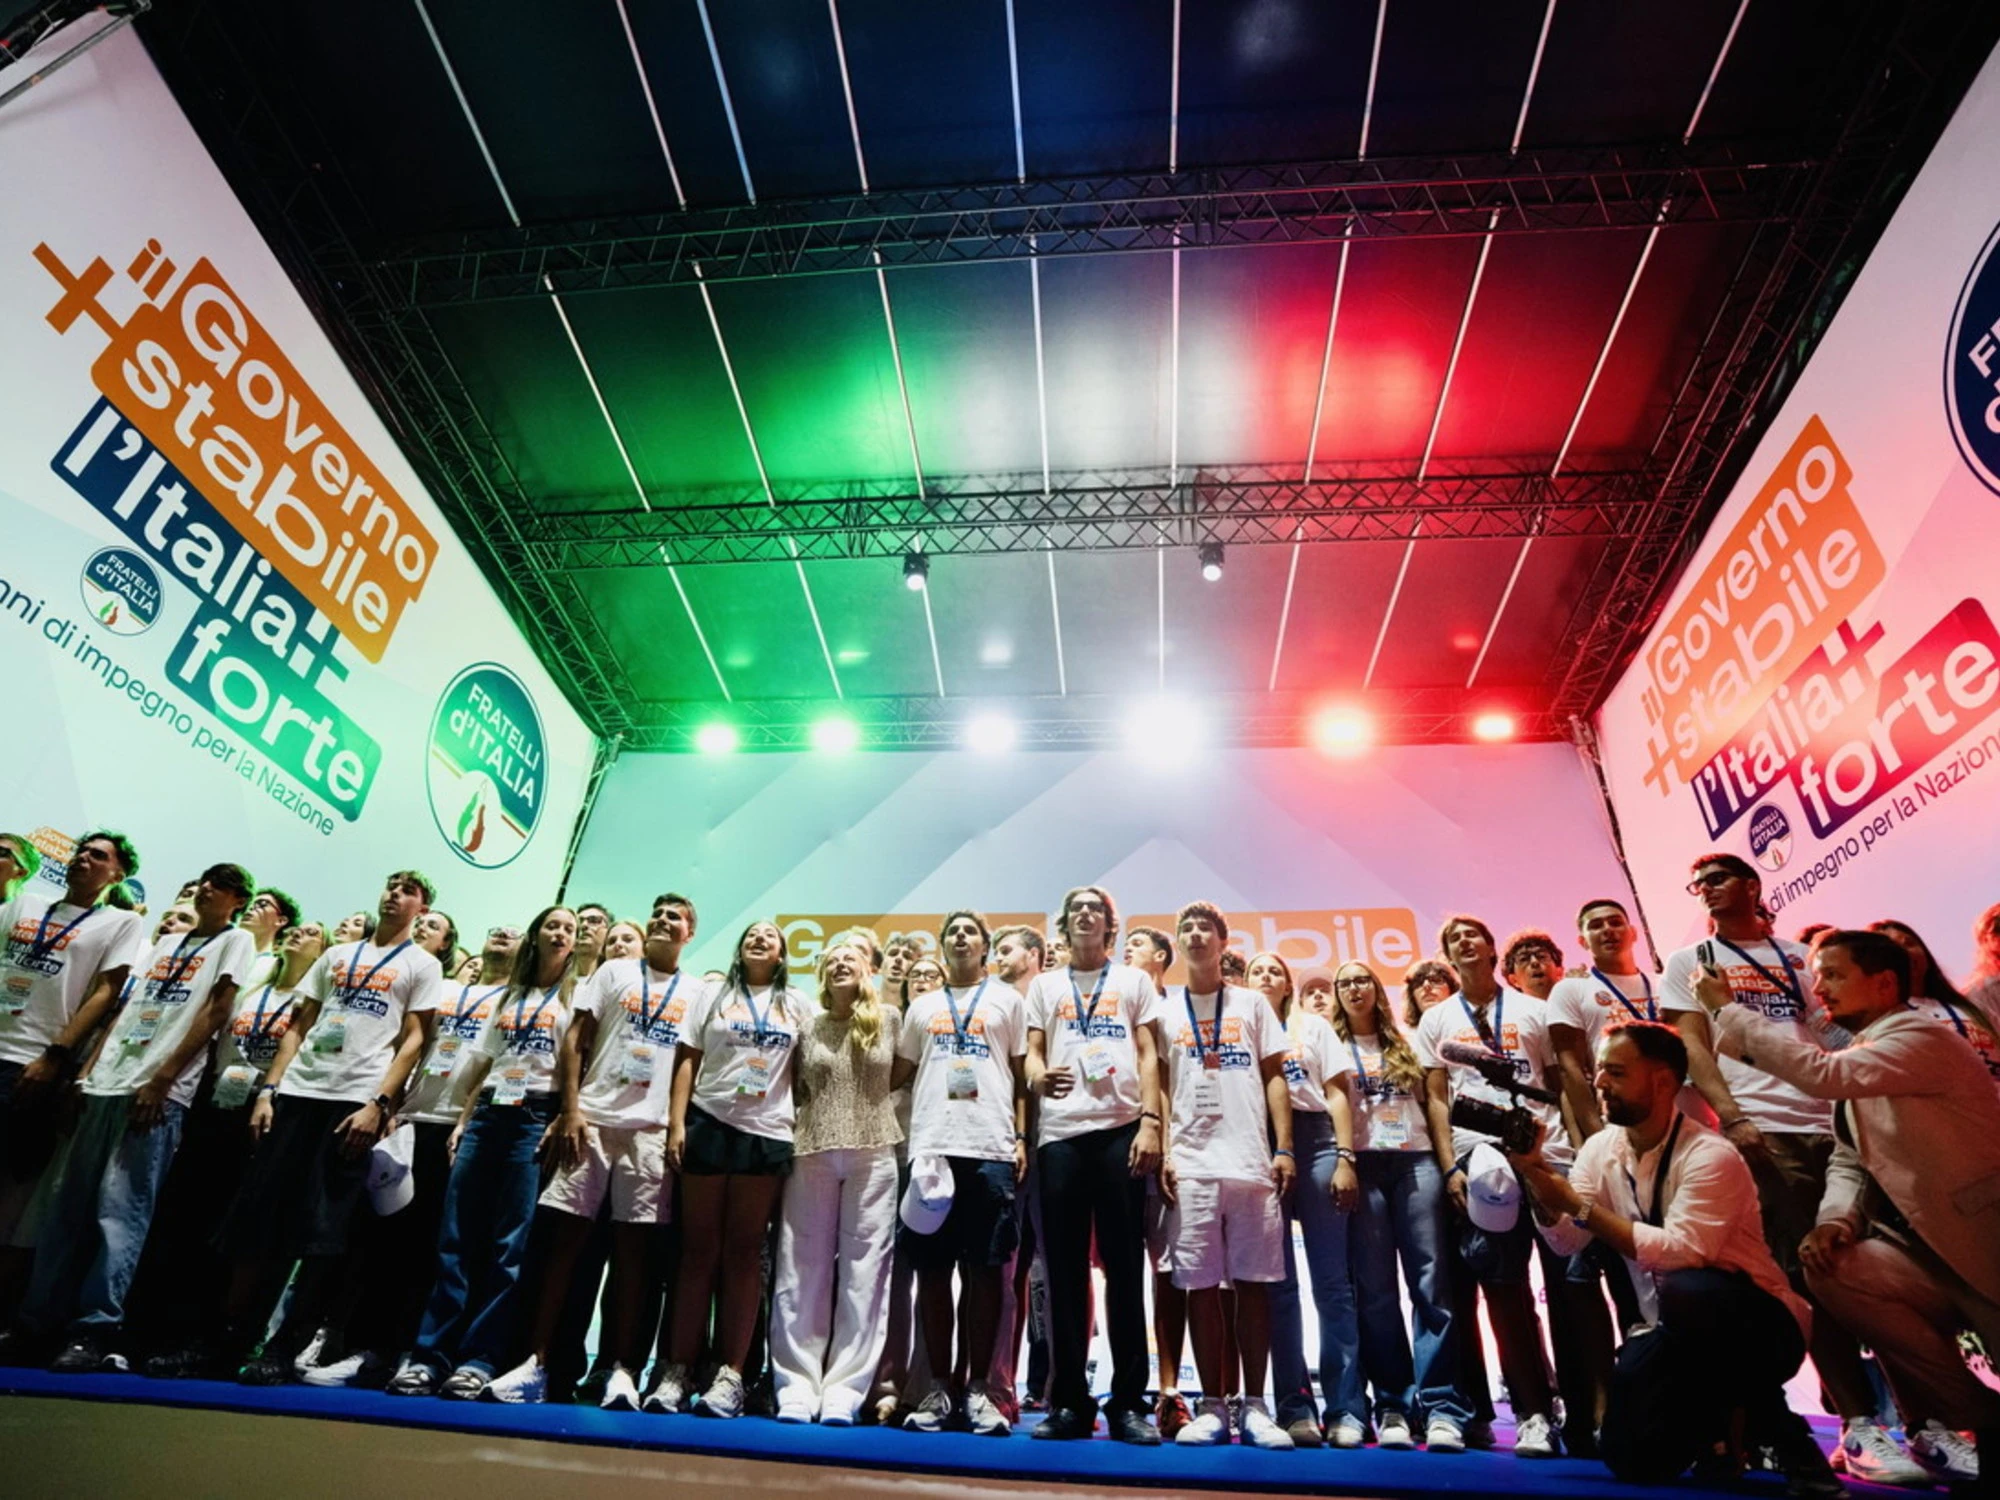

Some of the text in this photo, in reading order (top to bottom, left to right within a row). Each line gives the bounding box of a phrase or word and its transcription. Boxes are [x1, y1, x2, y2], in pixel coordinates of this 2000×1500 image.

[127, 237, 427, 583] il Governo
[96, 563, 154, 615] d'ITALIA
[107, 554, 158, 599] FRATELLI
[1655, 445, 1836, 695] Governo
[43, 618, 78, 649] di
[74, 634, 193, 734] impegno
[191, 726, 236, 764] per
[235, 750, 257, 781] la
[256, 766, 334, 836] Nazione
[178, 618, 365, 802] forte
[450, 708, 534, 808] d'ITALIA
[468, 683, 540, 771] FRATELLI
[1800, 641, 2000, 829] forte
[1769, 731, 2000, 914] di impegno per la Nazion
[1229, 915, 1414, 971] abile
